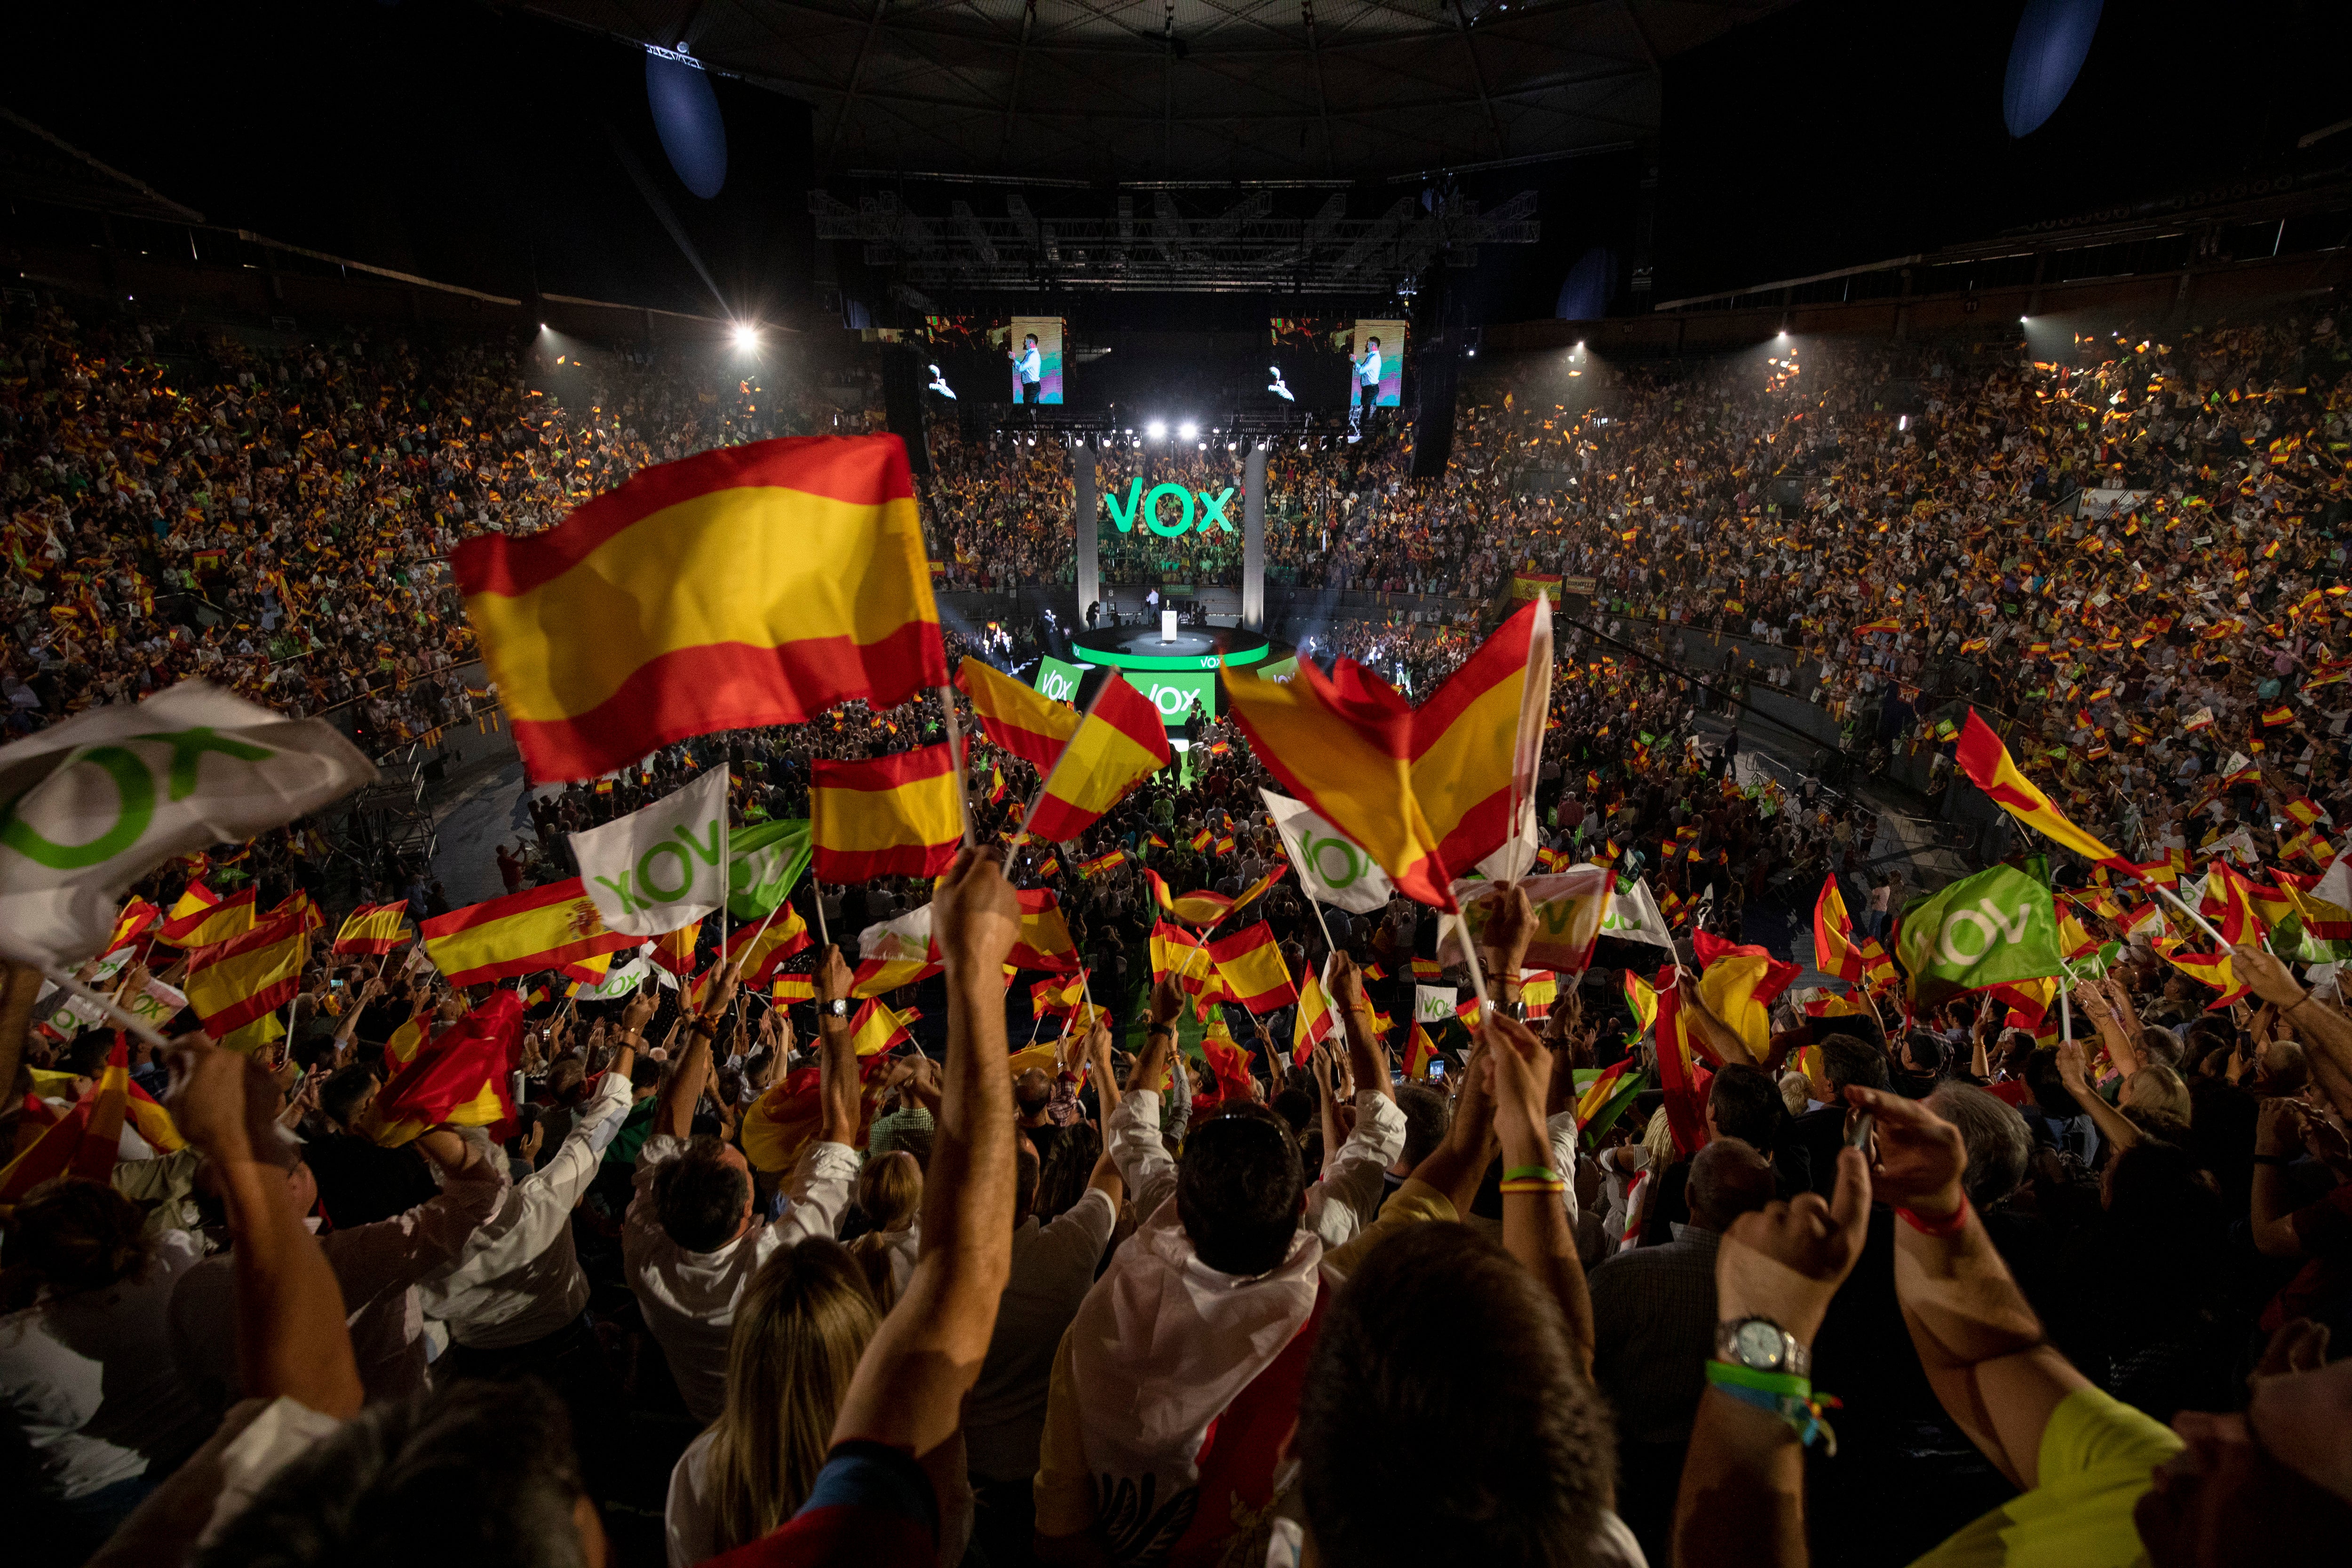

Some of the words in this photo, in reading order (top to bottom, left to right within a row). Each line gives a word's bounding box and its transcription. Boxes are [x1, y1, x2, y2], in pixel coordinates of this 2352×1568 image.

[1105, 477, 1234, 537] VOX
[1042, 669, 1073, 700] VOX
[595, 971, 641, 996] VOX
[1424, 996, 1453, 1017] VOX
